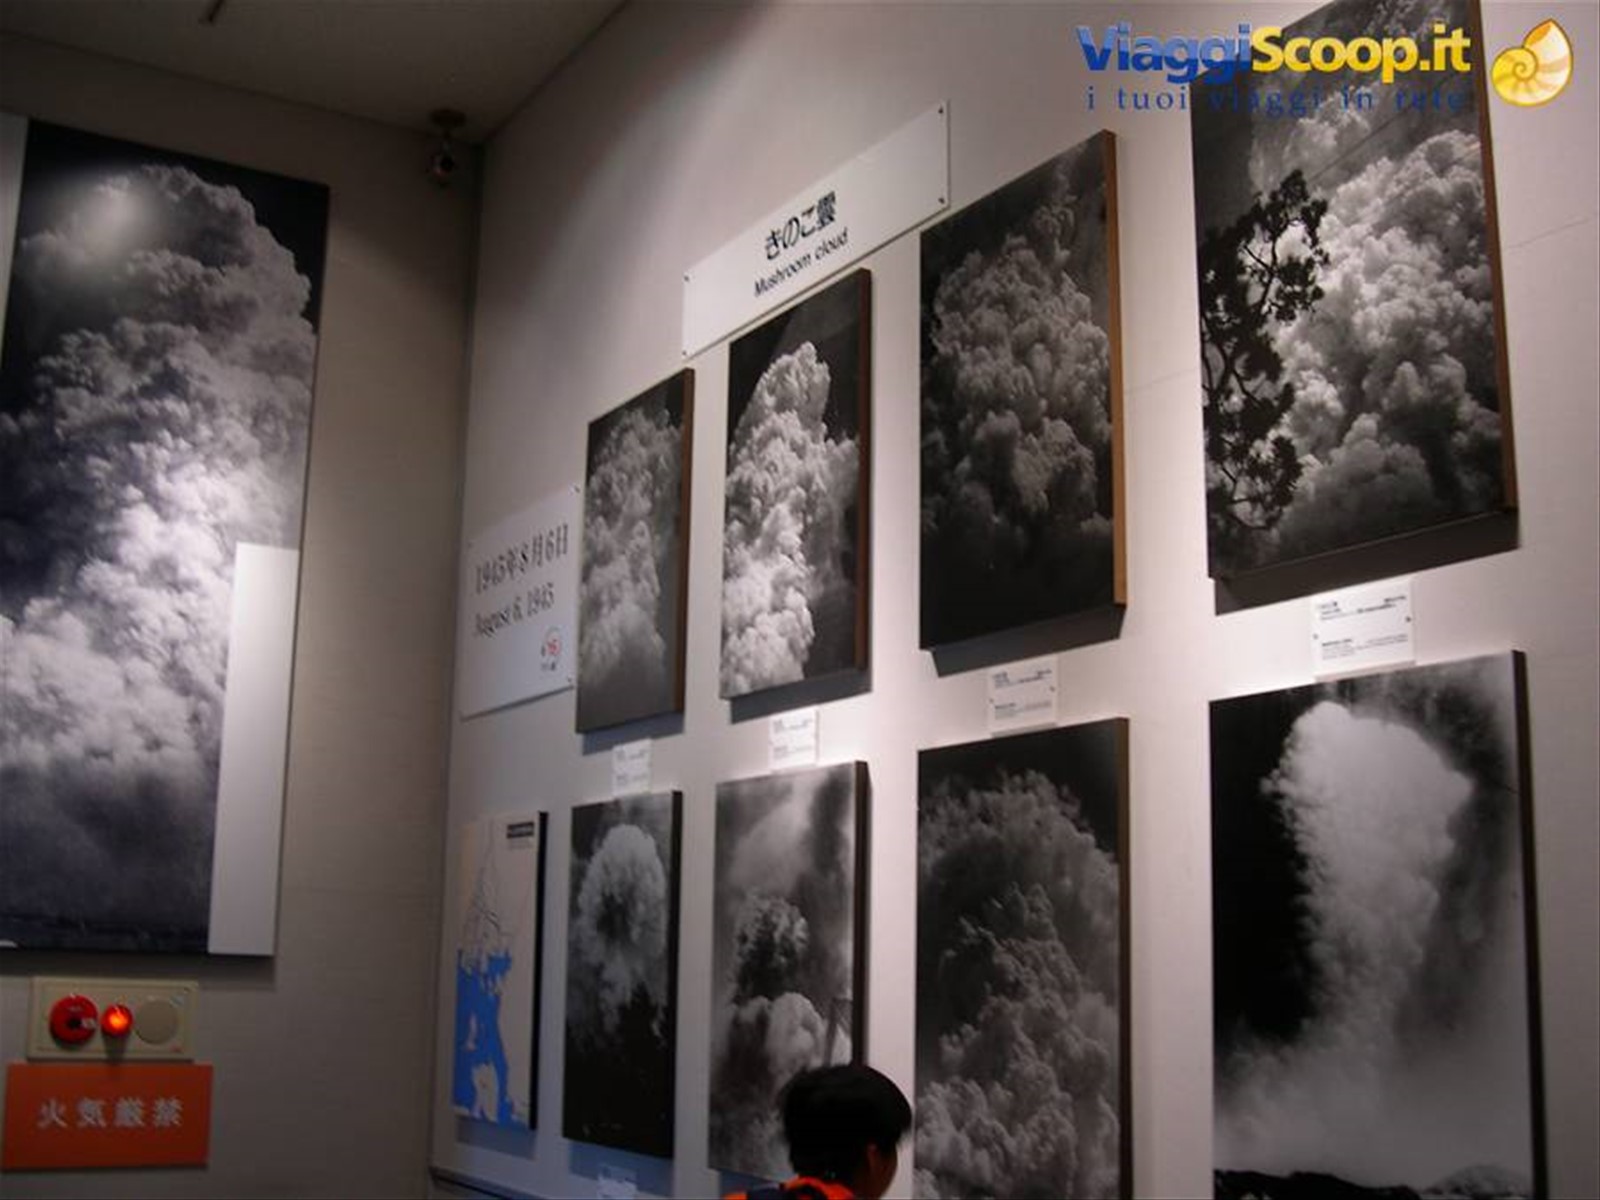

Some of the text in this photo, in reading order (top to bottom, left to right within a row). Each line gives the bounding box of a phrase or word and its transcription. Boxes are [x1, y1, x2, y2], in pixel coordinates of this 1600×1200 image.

[765, 191, 837, 260] きのこ雲
[754, 227, 849, 297] Mushroom cloud
[475, 606, 511, 638] August
